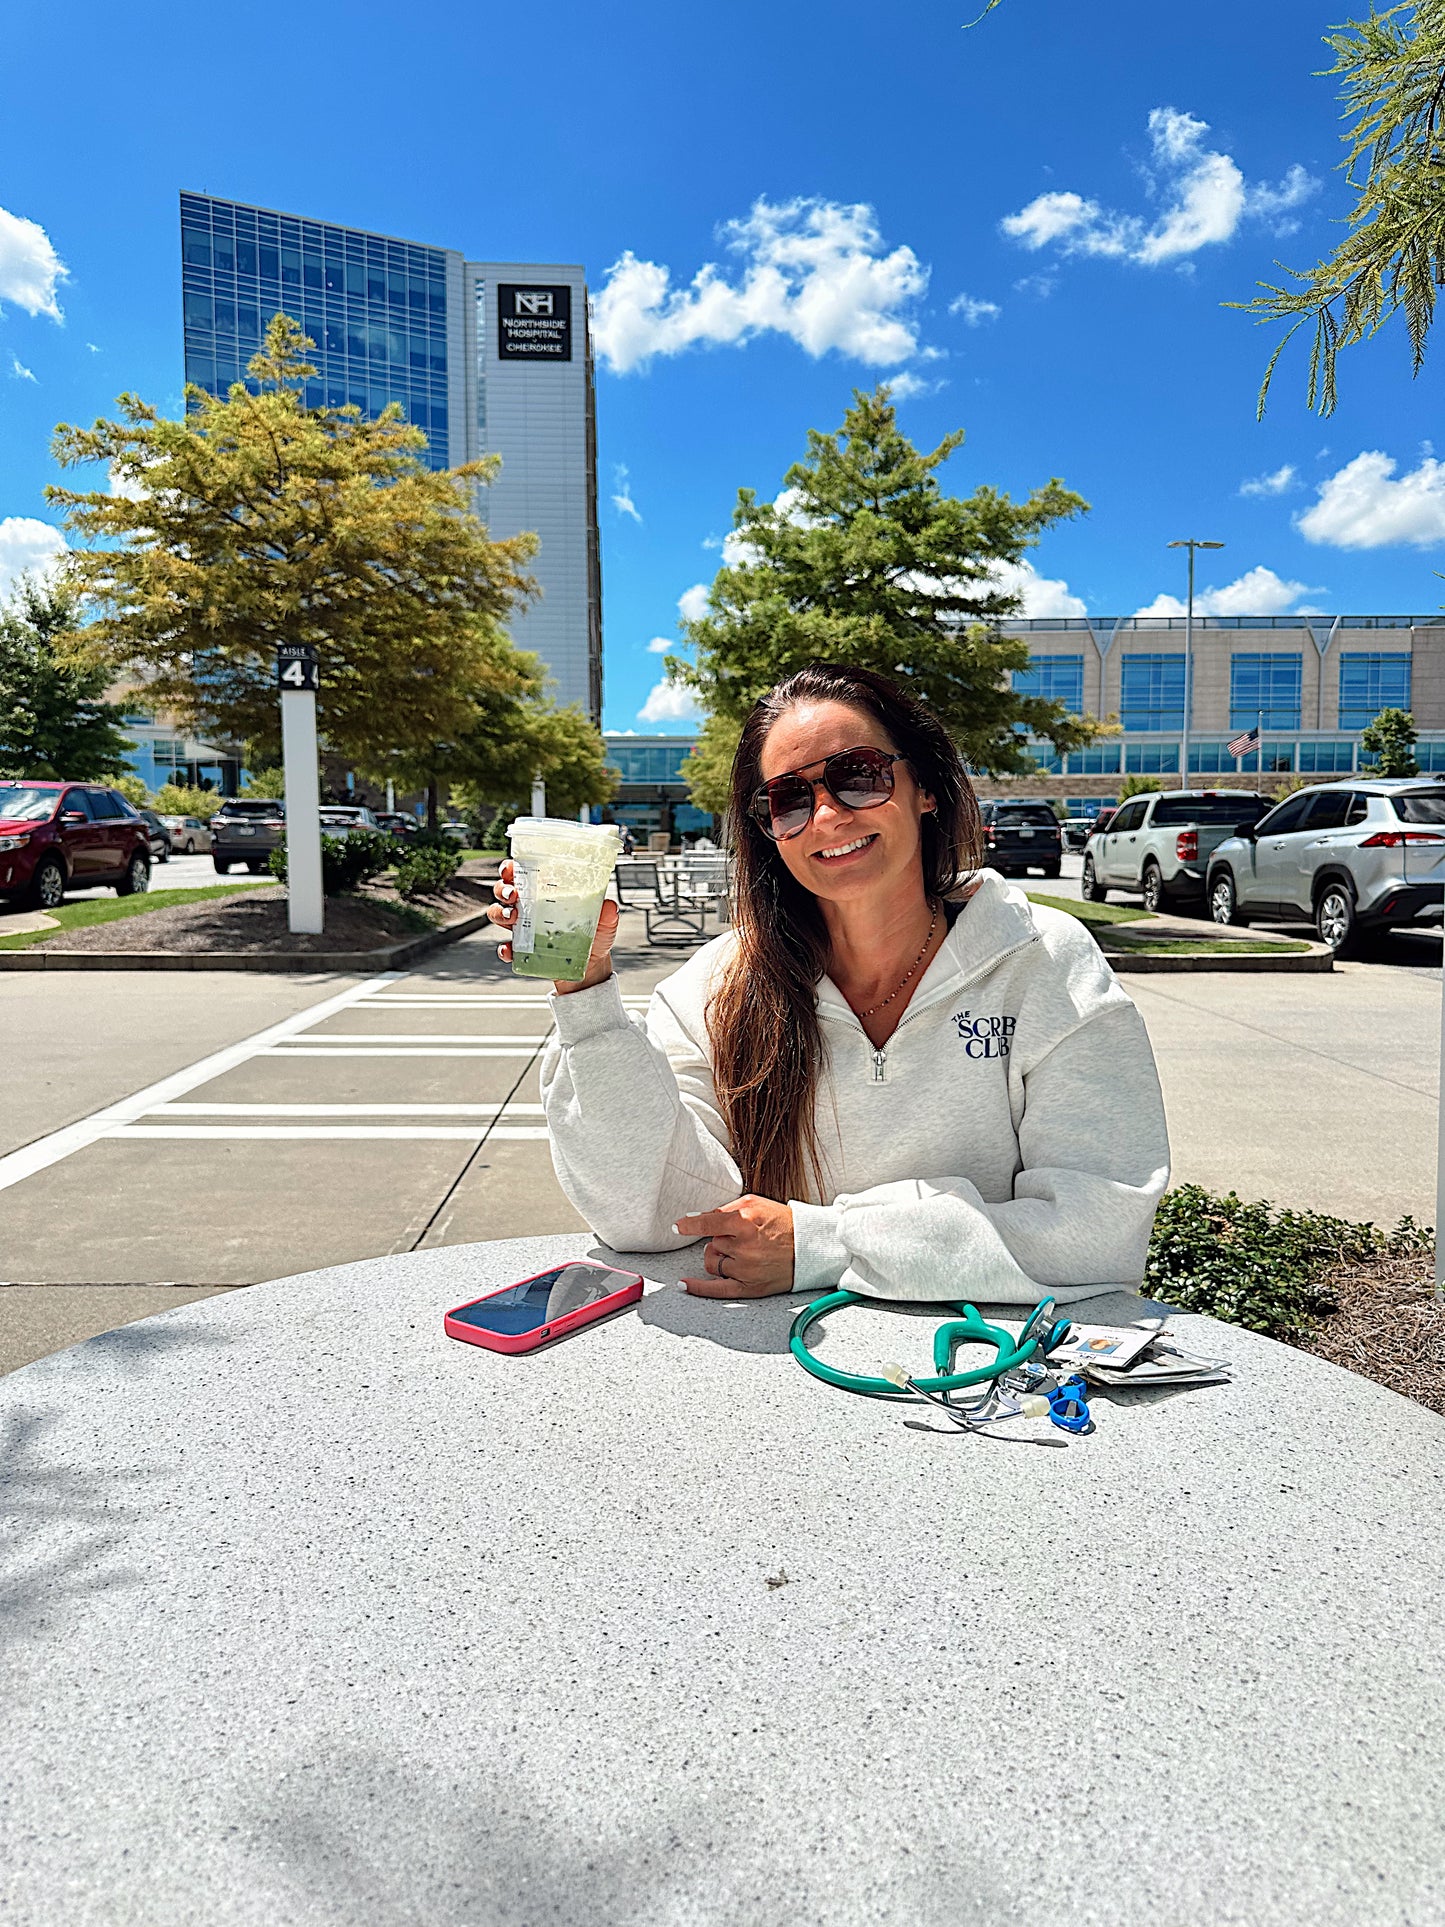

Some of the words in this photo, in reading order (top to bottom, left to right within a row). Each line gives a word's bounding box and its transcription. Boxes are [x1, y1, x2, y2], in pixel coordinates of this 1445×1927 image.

[503, 318, 566, 329] NORTHSIDE
[508, 329, 562, 338] HOSPITAL
[506, 343, 563, 352] CHEROKEE
[282, 647, 306, 656] AISLE
[281, 660, 305, 686] 4
[951, 1011, 970, 1022] THE
[958, 1016, 1016, 1038] SCRB
[966, 1037, 1009, 1058] CLB
